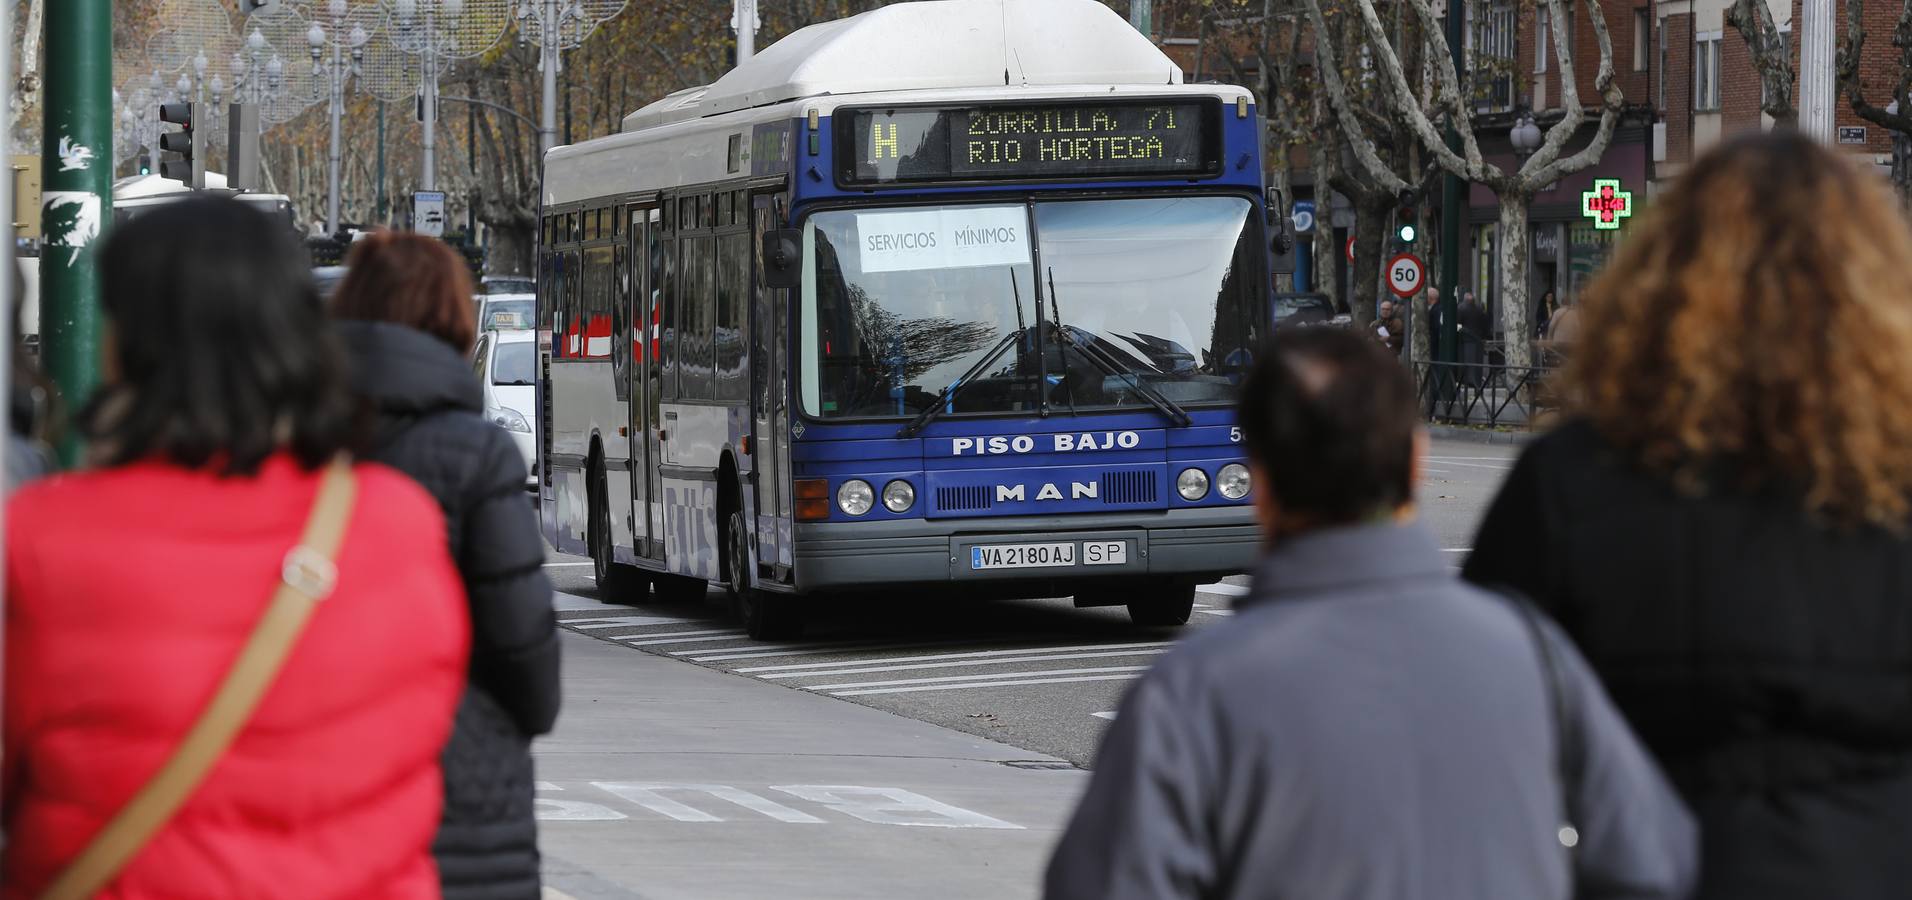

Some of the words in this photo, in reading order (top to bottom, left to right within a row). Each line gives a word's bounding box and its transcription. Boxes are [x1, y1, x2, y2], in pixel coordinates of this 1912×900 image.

[968, 110, 1118, 135] ZORRILLA,
[1145, 106, 1176, 129] 71
[874, 123, 898, 158] H
[968, 139, 1022, 163] RIO
[1039, 135, 1163, 161] HORTEGA
[1589, 198, 1625, 211] 11:46
[868, 231, 937, 251] SERVICIOS
[954, 224, 1016, 246] MÍNIMOS
[1394, 267, 1416, 282] 50
[952, 435, 1034, 455] PISO
[1054, 431, 1140, 451] BAJO
[1229, 426, 1247, 442] 5
[996, 481, 1099, 502] MAN
[665, 487, 719, 578] BUS
[982, 548, 1003, 566] VA
[1006, 547, 1049, 565] 2180
[1053, 546, 1073, 563] AJ
[1088, 544, 1121, 562] SP
